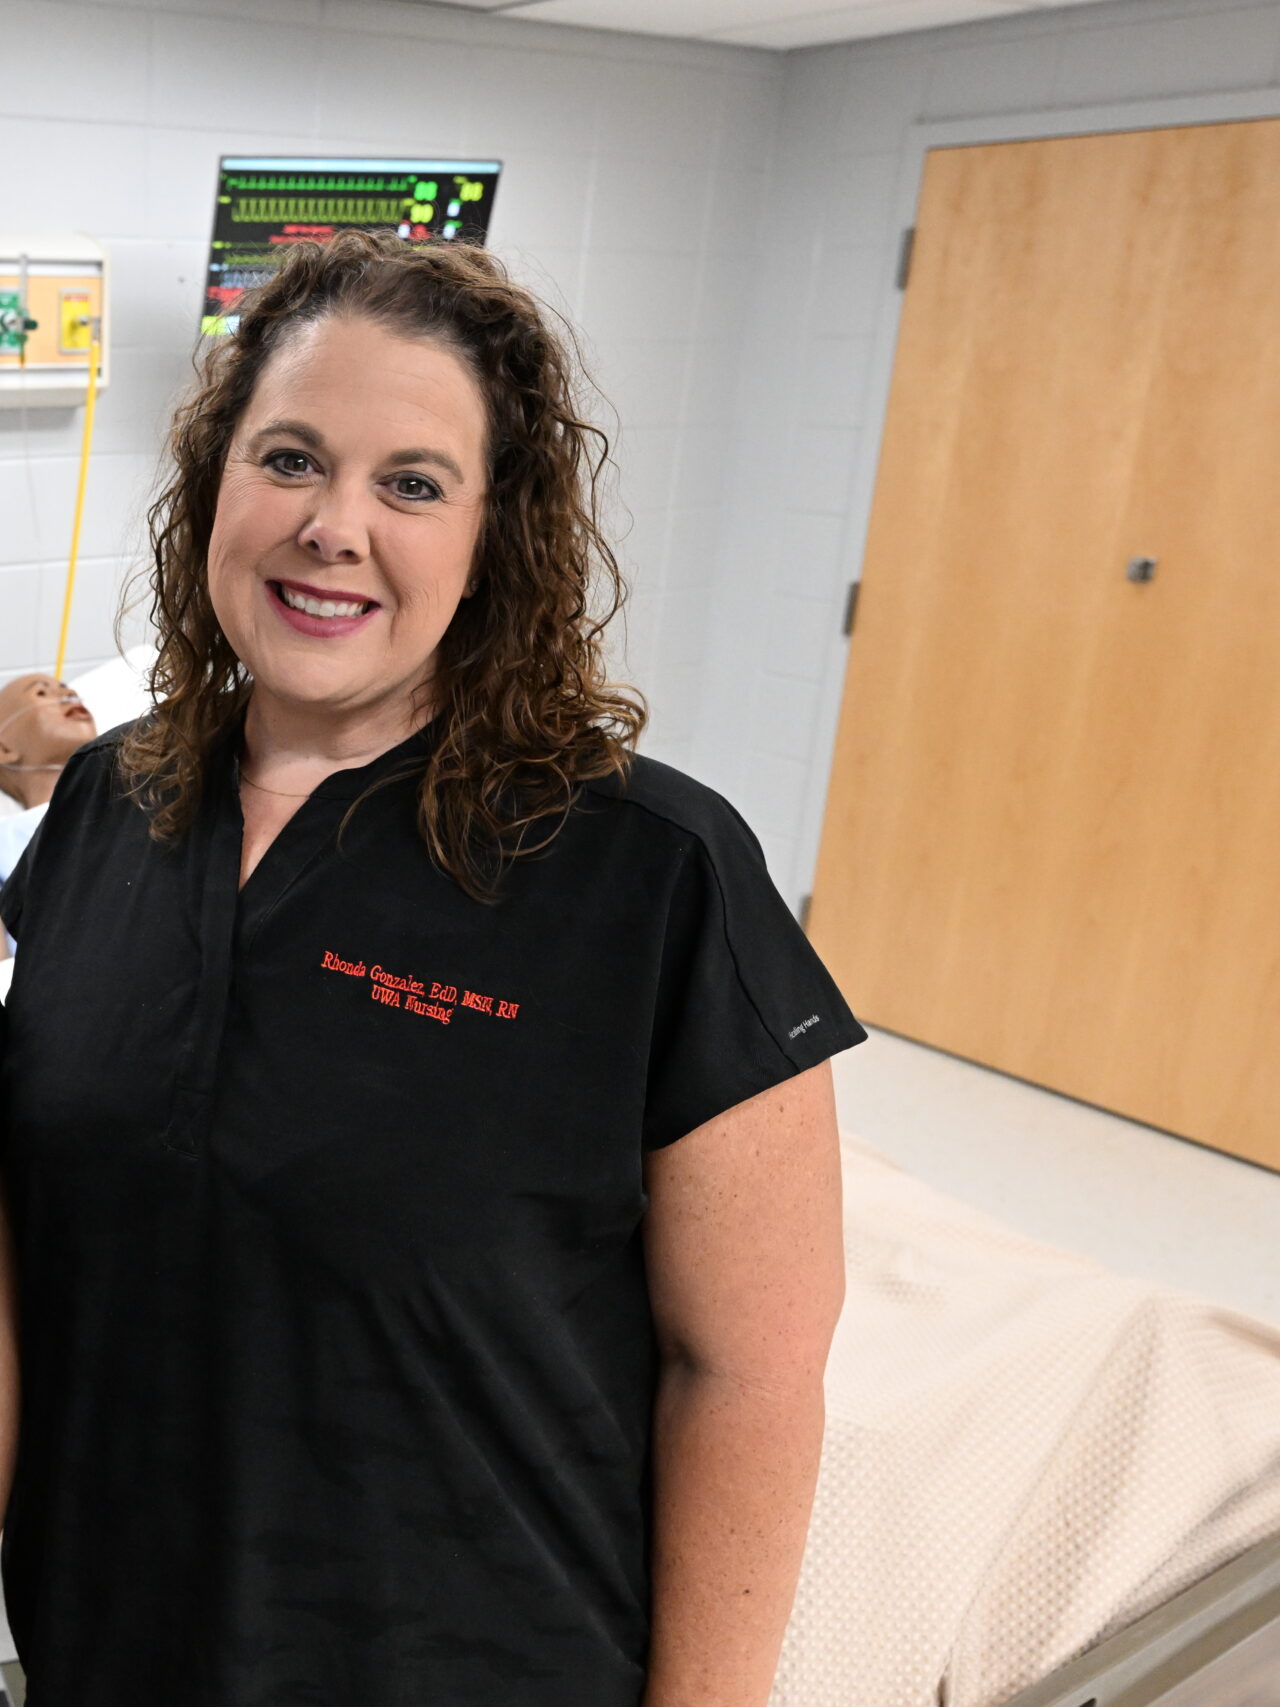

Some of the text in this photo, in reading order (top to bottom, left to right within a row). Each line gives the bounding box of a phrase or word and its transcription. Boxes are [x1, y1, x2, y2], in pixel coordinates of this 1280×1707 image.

[320, 950, 520, 1019] Rhonda Gonzalez, EdD, MSN, RN
[371, 984, 454, 1025] UWA Nursing
[802, 1014, 820, 1029] Hands
